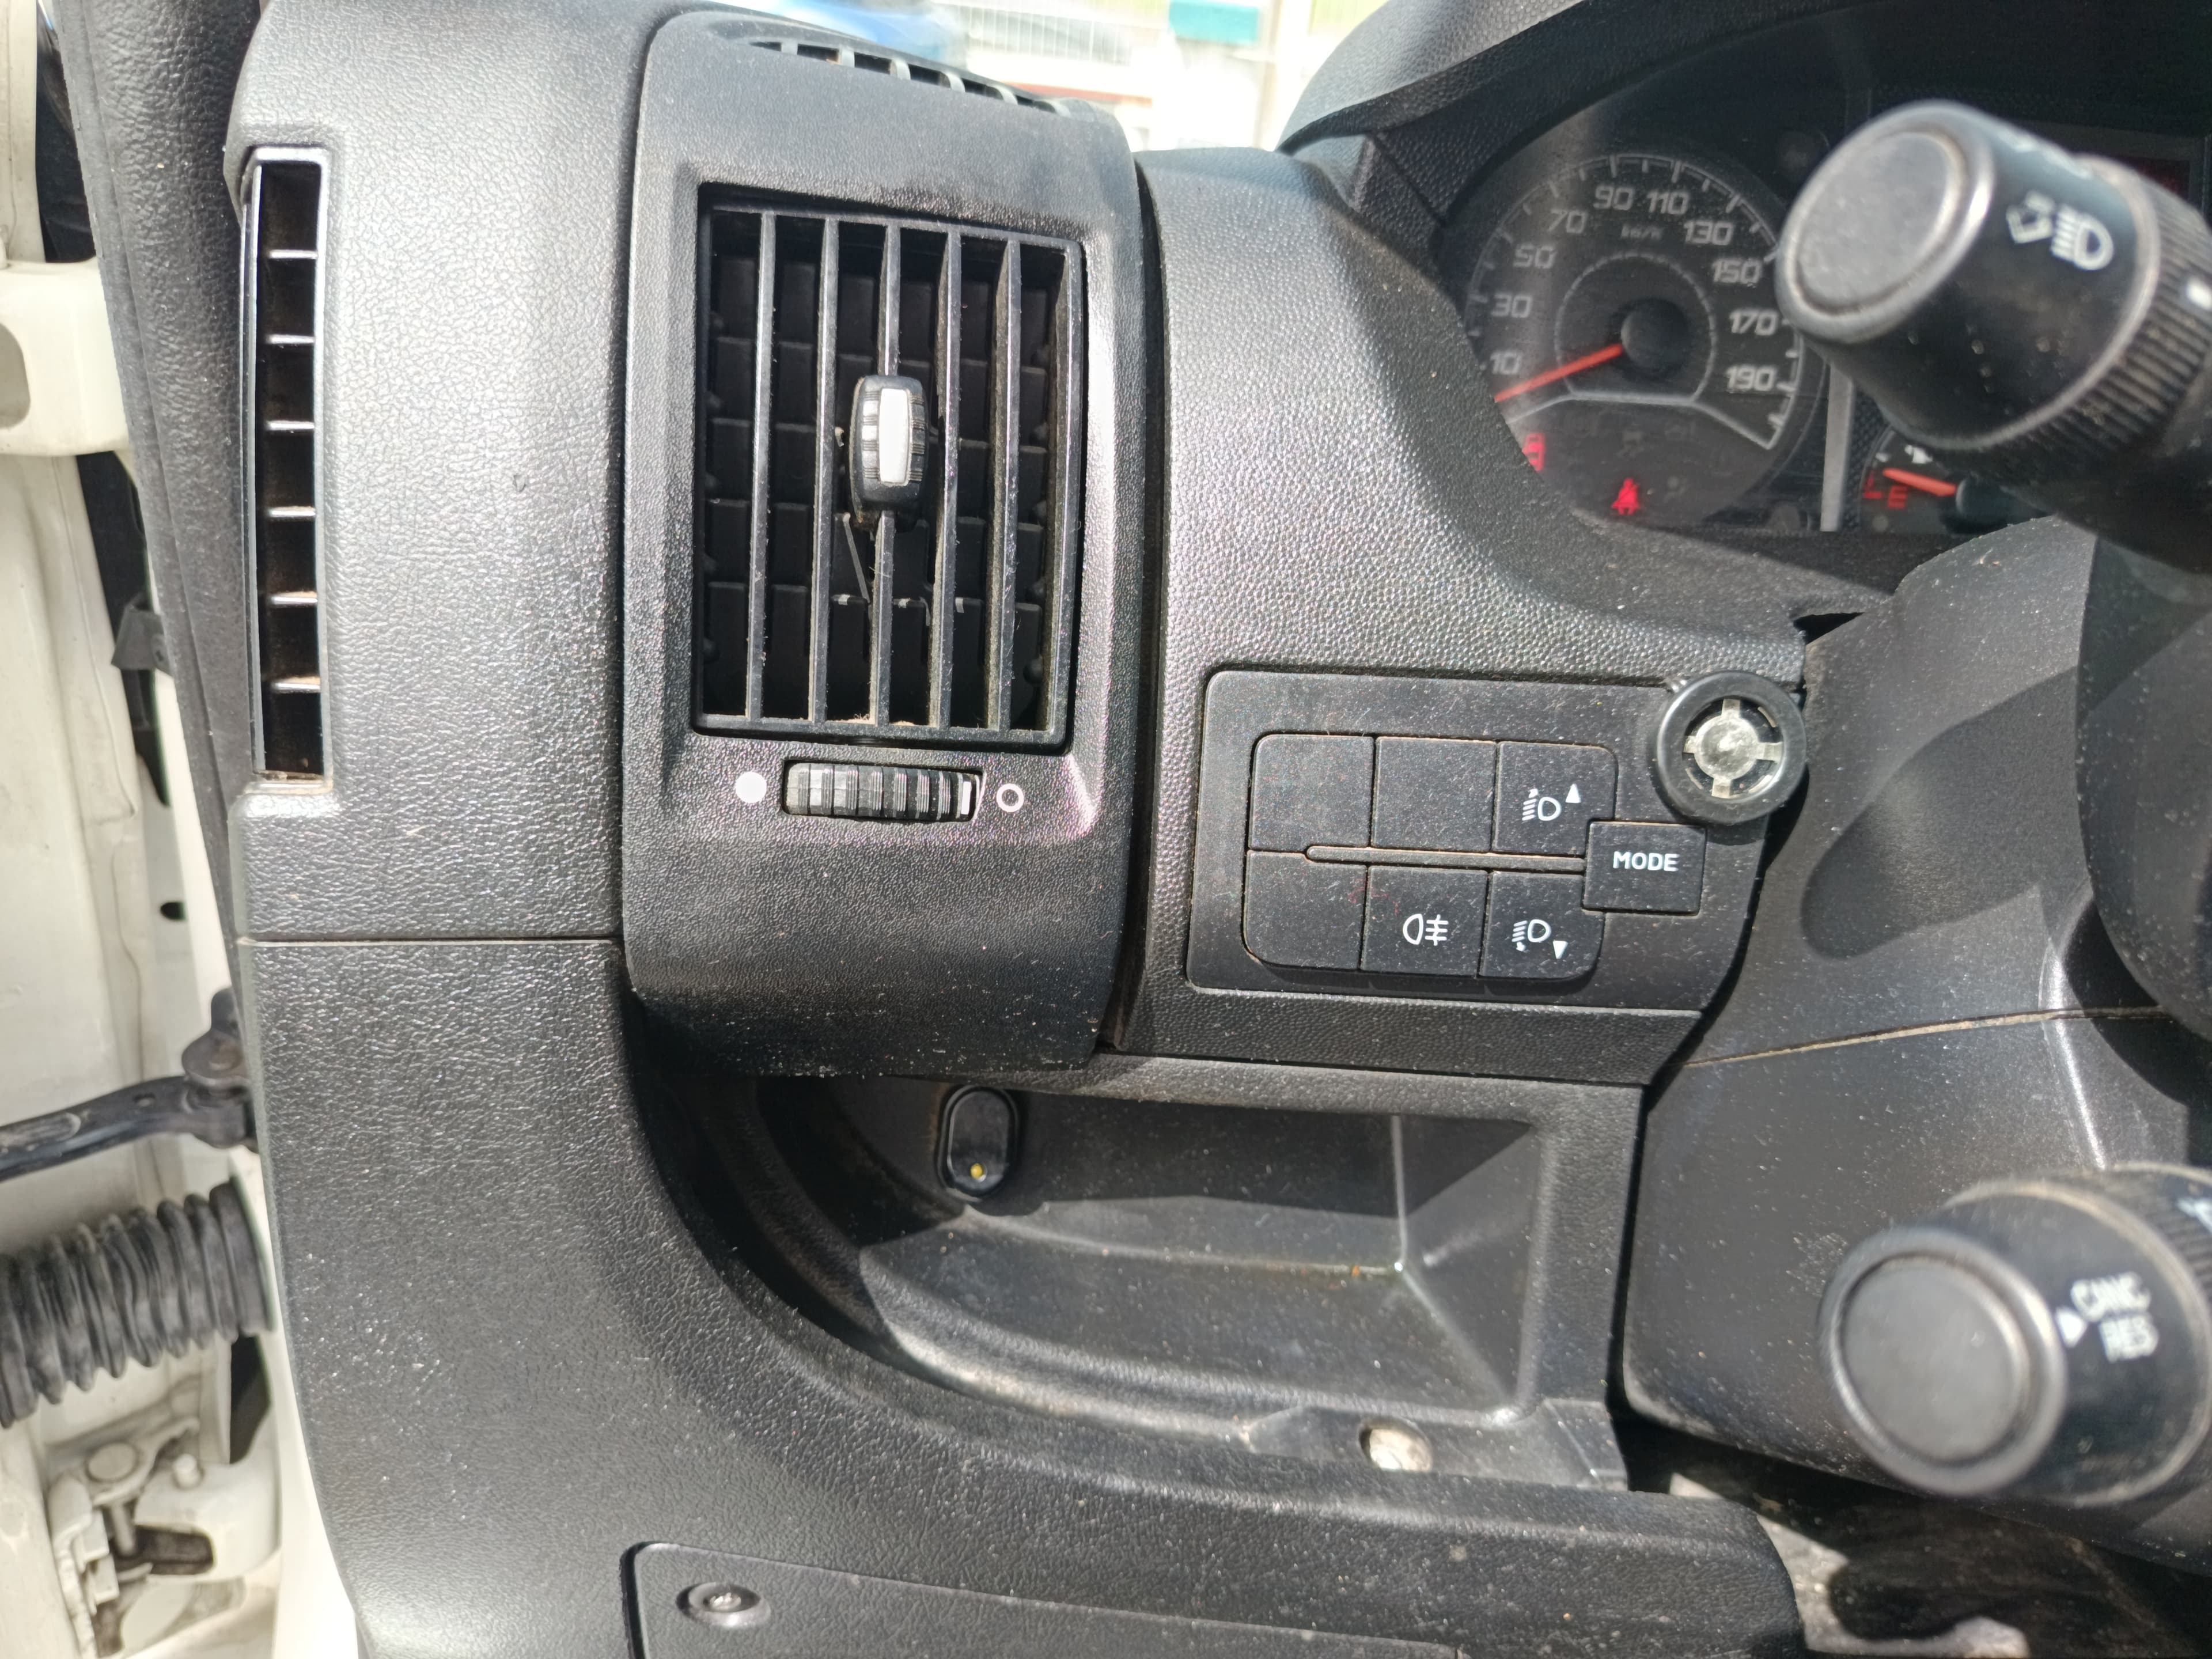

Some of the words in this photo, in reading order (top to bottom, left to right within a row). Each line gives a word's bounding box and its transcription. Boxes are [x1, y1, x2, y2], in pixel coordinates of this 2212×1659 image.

[1593, 185, 1634, 211] 90
[1646, 190, 1689, 215] 110
[1549, 209, 1588, 234] 70
[1683, 220, 1733, 246] 130
[1512, 244, 1556, 269] 50
[1711, 257, 1763, 286] 150
[1491, 294, 1532, 318] 30
[1729, 309, 1778, 336] 170
[1490, 350, 1522, 376] 10
[1725, 366, 1777, 392] 190
[1613, 850, 1679, 872] MODE
